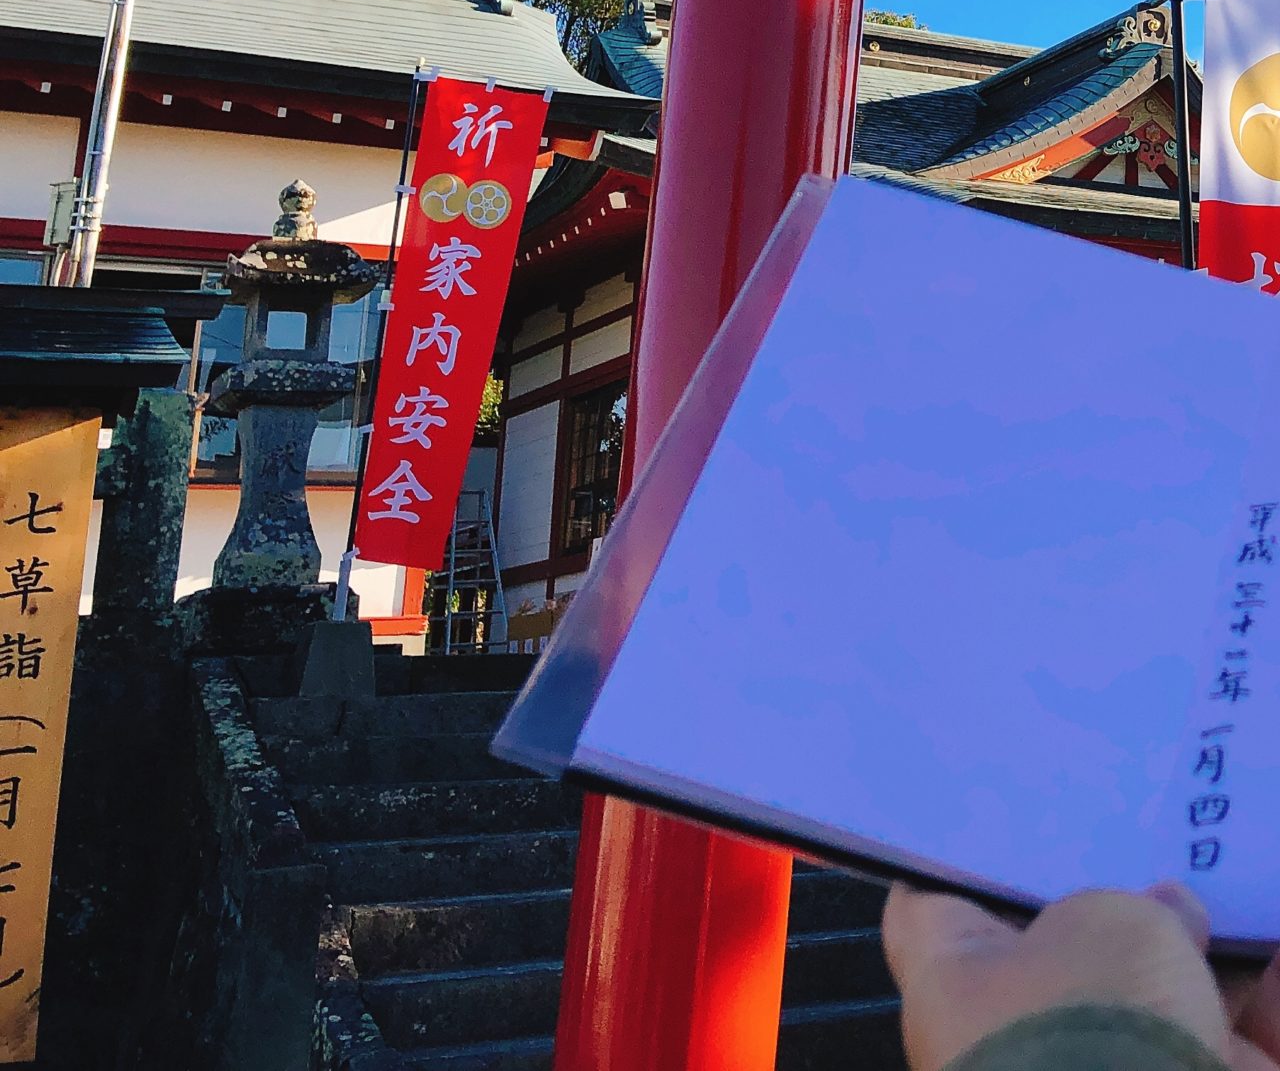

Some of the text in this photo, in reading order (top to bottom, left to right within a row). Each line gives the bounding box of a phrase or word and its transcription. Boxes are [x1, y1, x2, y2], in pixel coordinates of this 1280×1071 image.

[367, 103, 513, 525] 祈 家内安全
